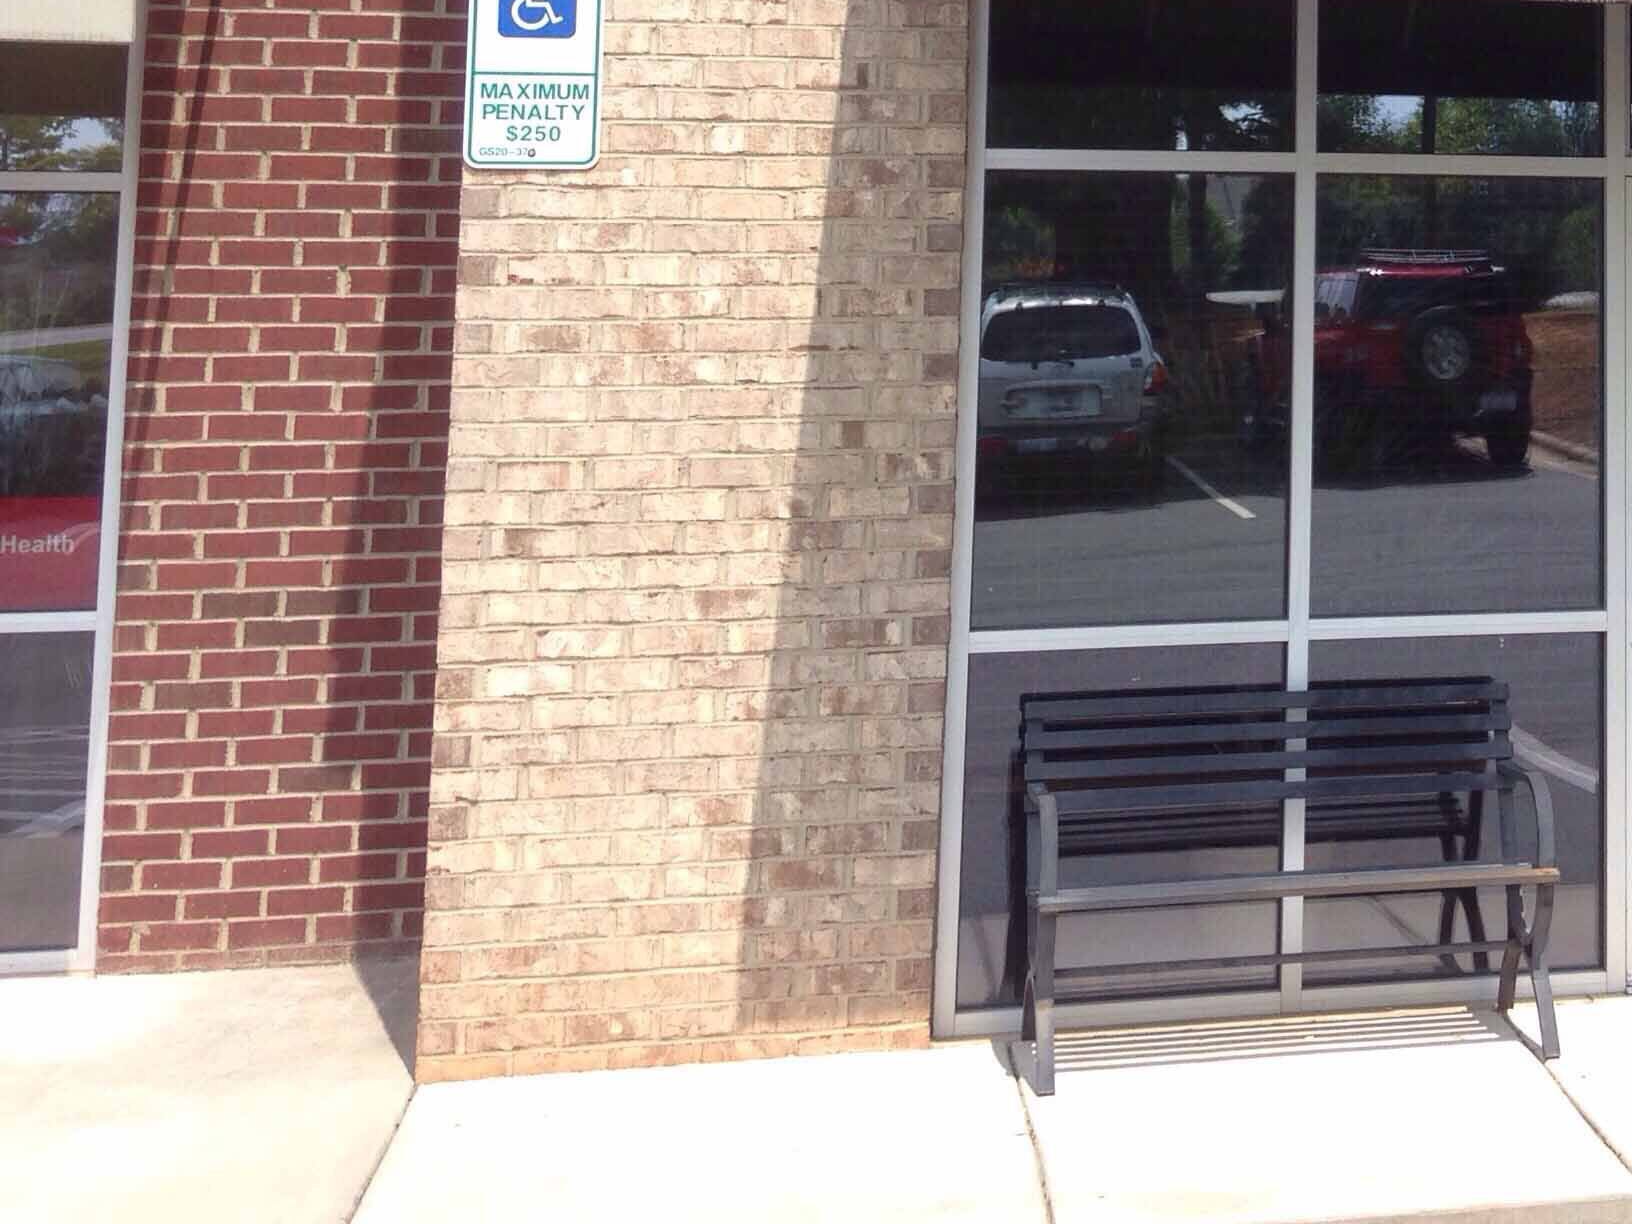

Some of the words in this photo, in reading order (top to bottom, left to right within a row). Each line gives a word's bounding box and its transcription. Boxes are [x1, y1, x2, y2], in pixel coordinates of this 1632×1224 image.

[480, 82, 590, 101] MAXIMUM
[482, 103, 585, 121] PENALTY
[506, 126, 561, 142] $250
[1, 533, 75, 554] Health
